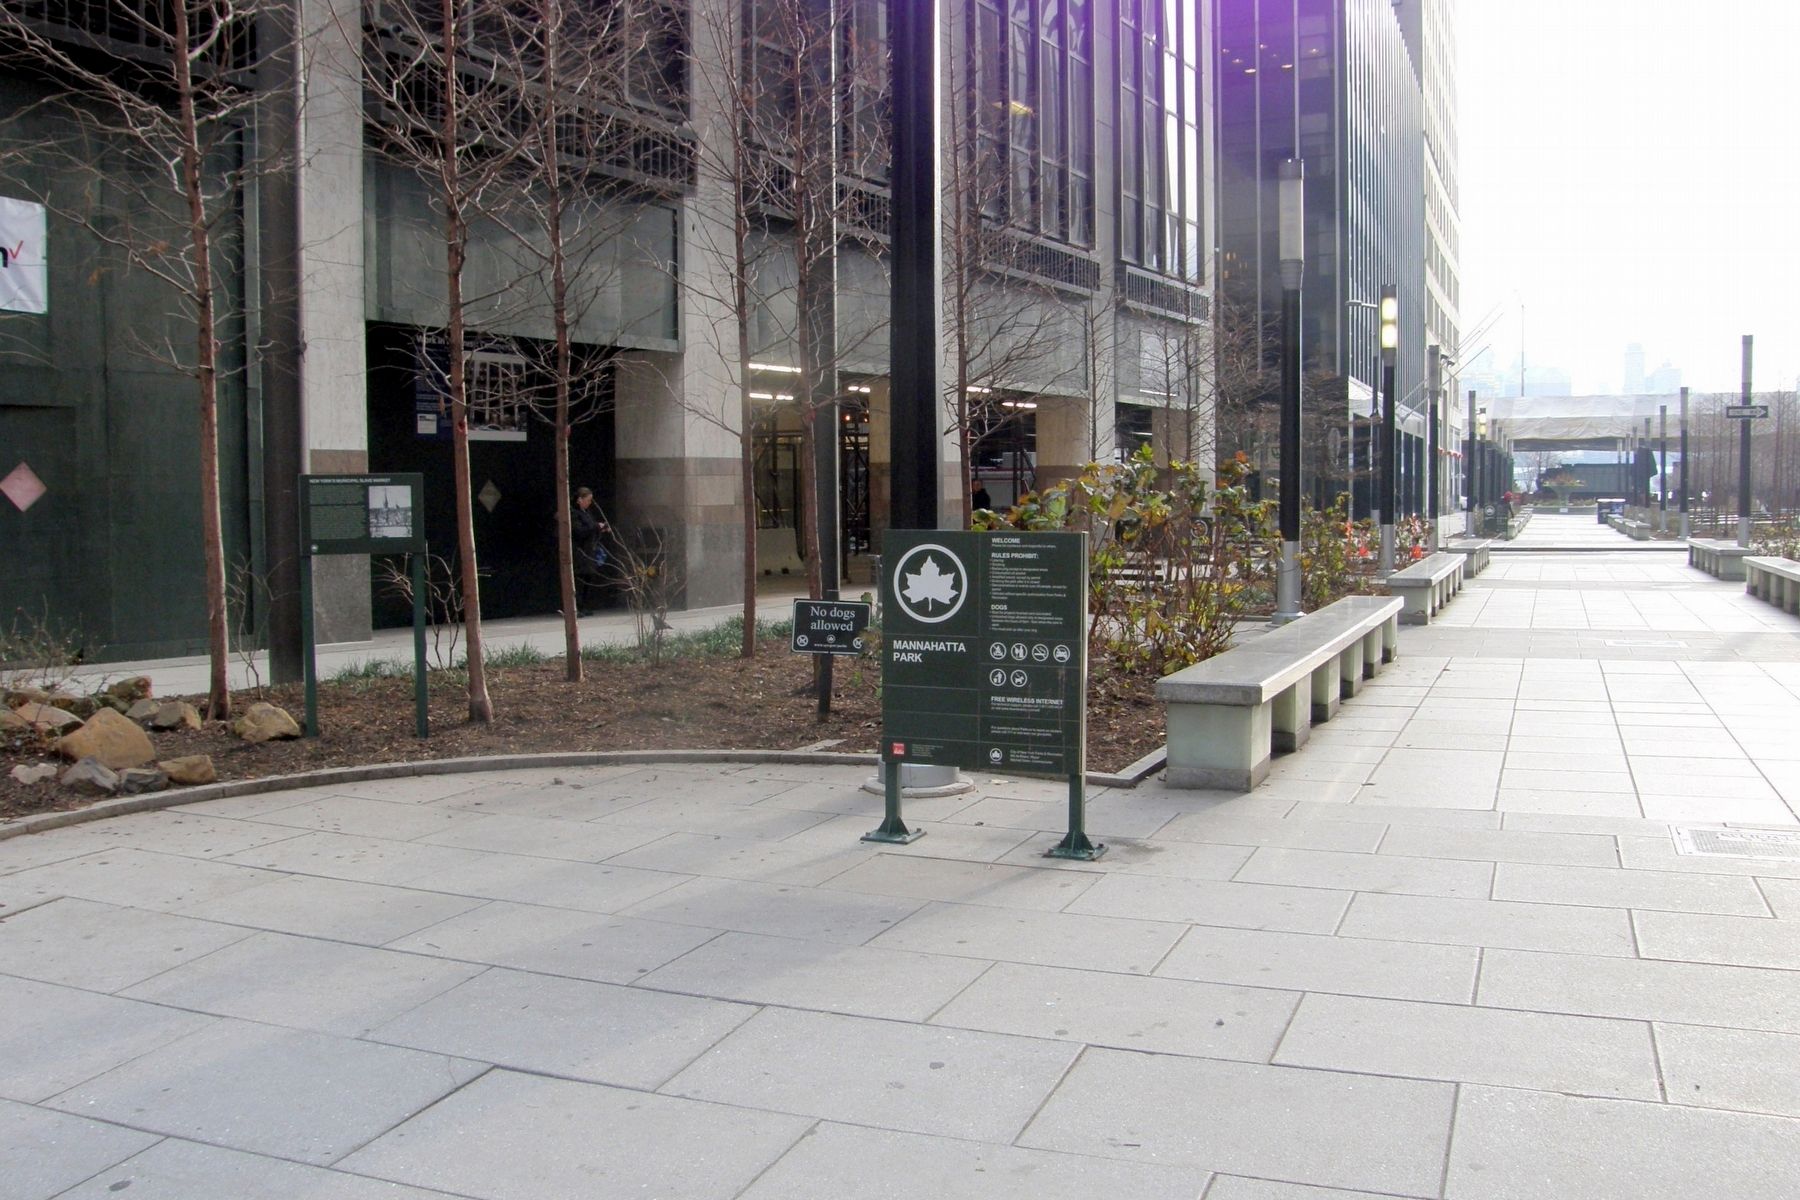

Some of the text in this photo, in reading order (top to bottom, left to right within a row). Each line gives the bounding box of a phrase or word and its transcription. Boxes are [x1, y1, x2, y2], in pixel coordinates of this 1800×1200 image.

[810, 606, 856, 620] No dogs
[810, 620, 854, 632] allowed
[893, 640, 967, 653] MANNAHATTA
[893, 652, 923, 663] PARK
